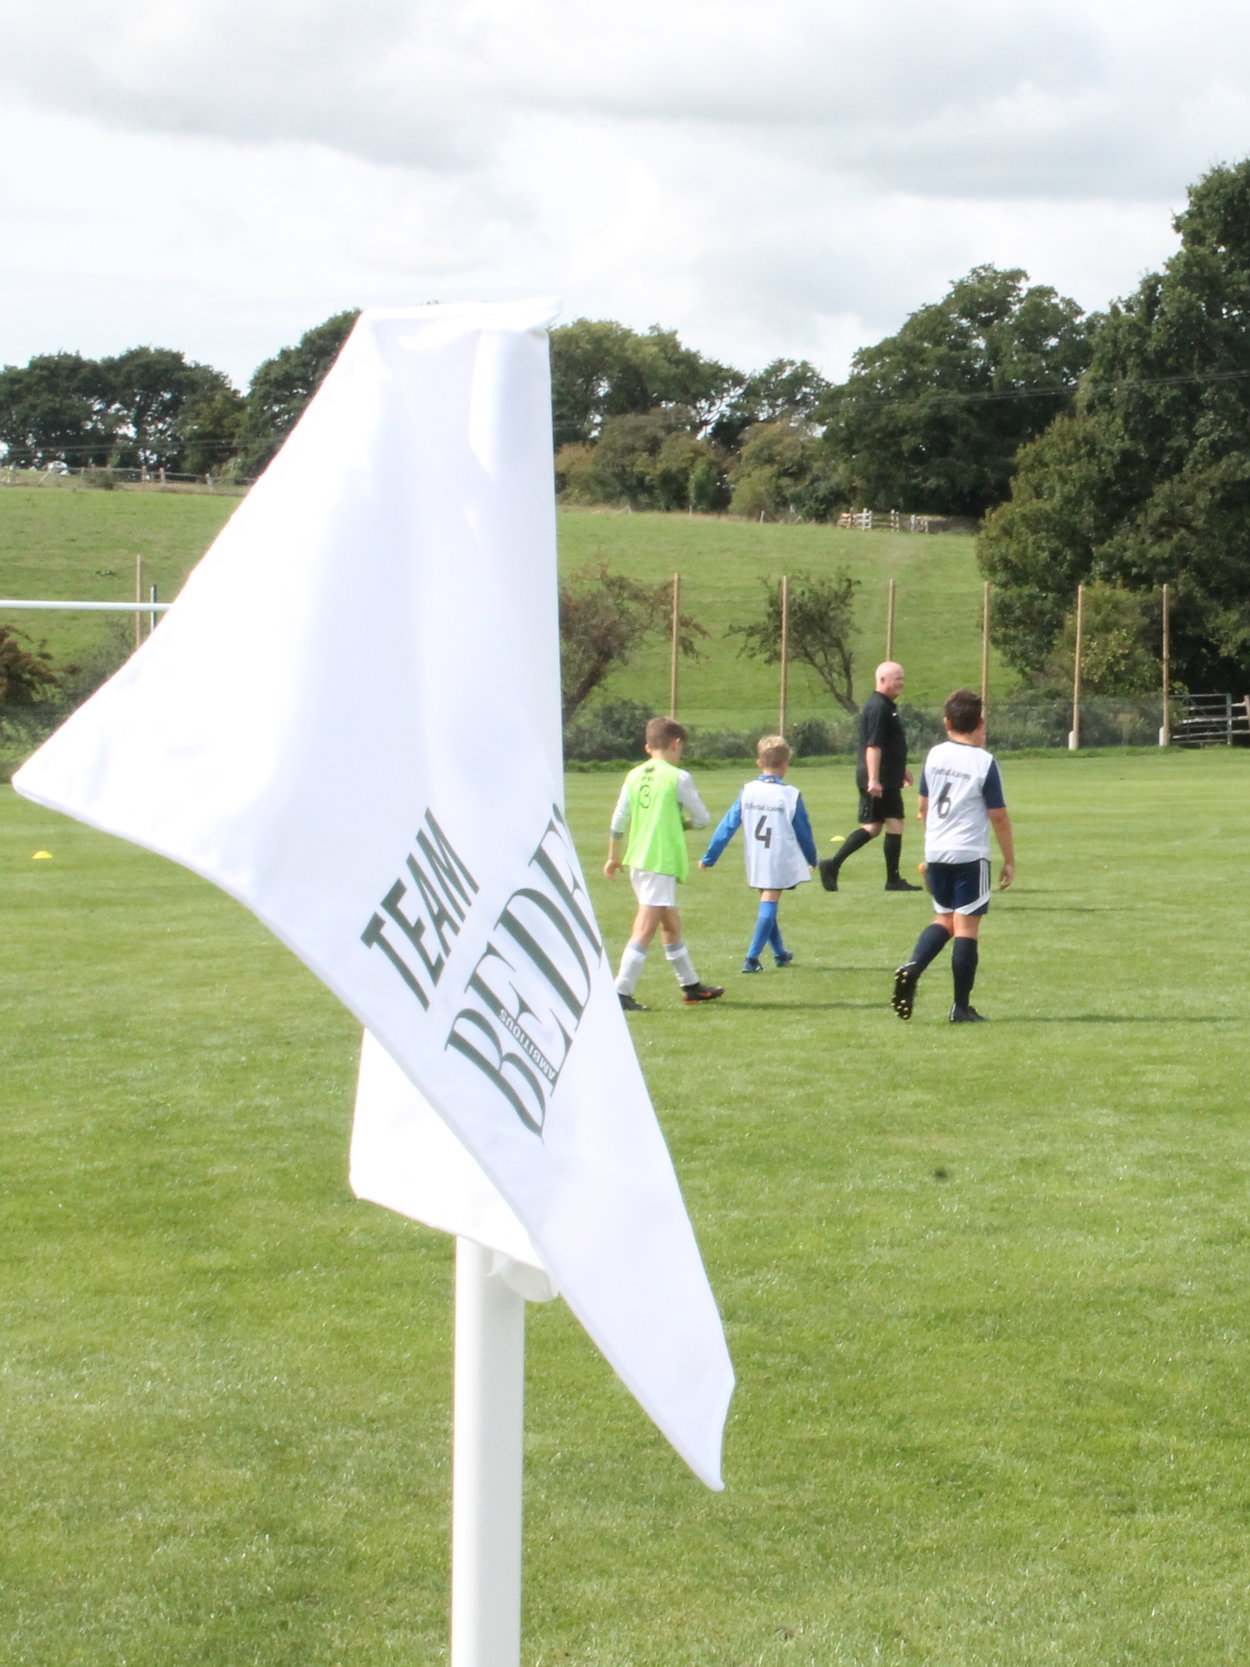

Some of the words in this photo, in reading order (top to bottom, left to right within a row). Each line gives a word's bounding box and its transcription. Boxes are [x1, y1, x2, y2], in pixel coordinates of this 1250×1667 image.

[639, 784, 652, 809] 3
[937, 782, 952, 819] 6
[754, 815, 772, 848] 4
[360, 806, 480, 1013] TEAM
[499, 1008, 557, 1081] AMBITIOUS
